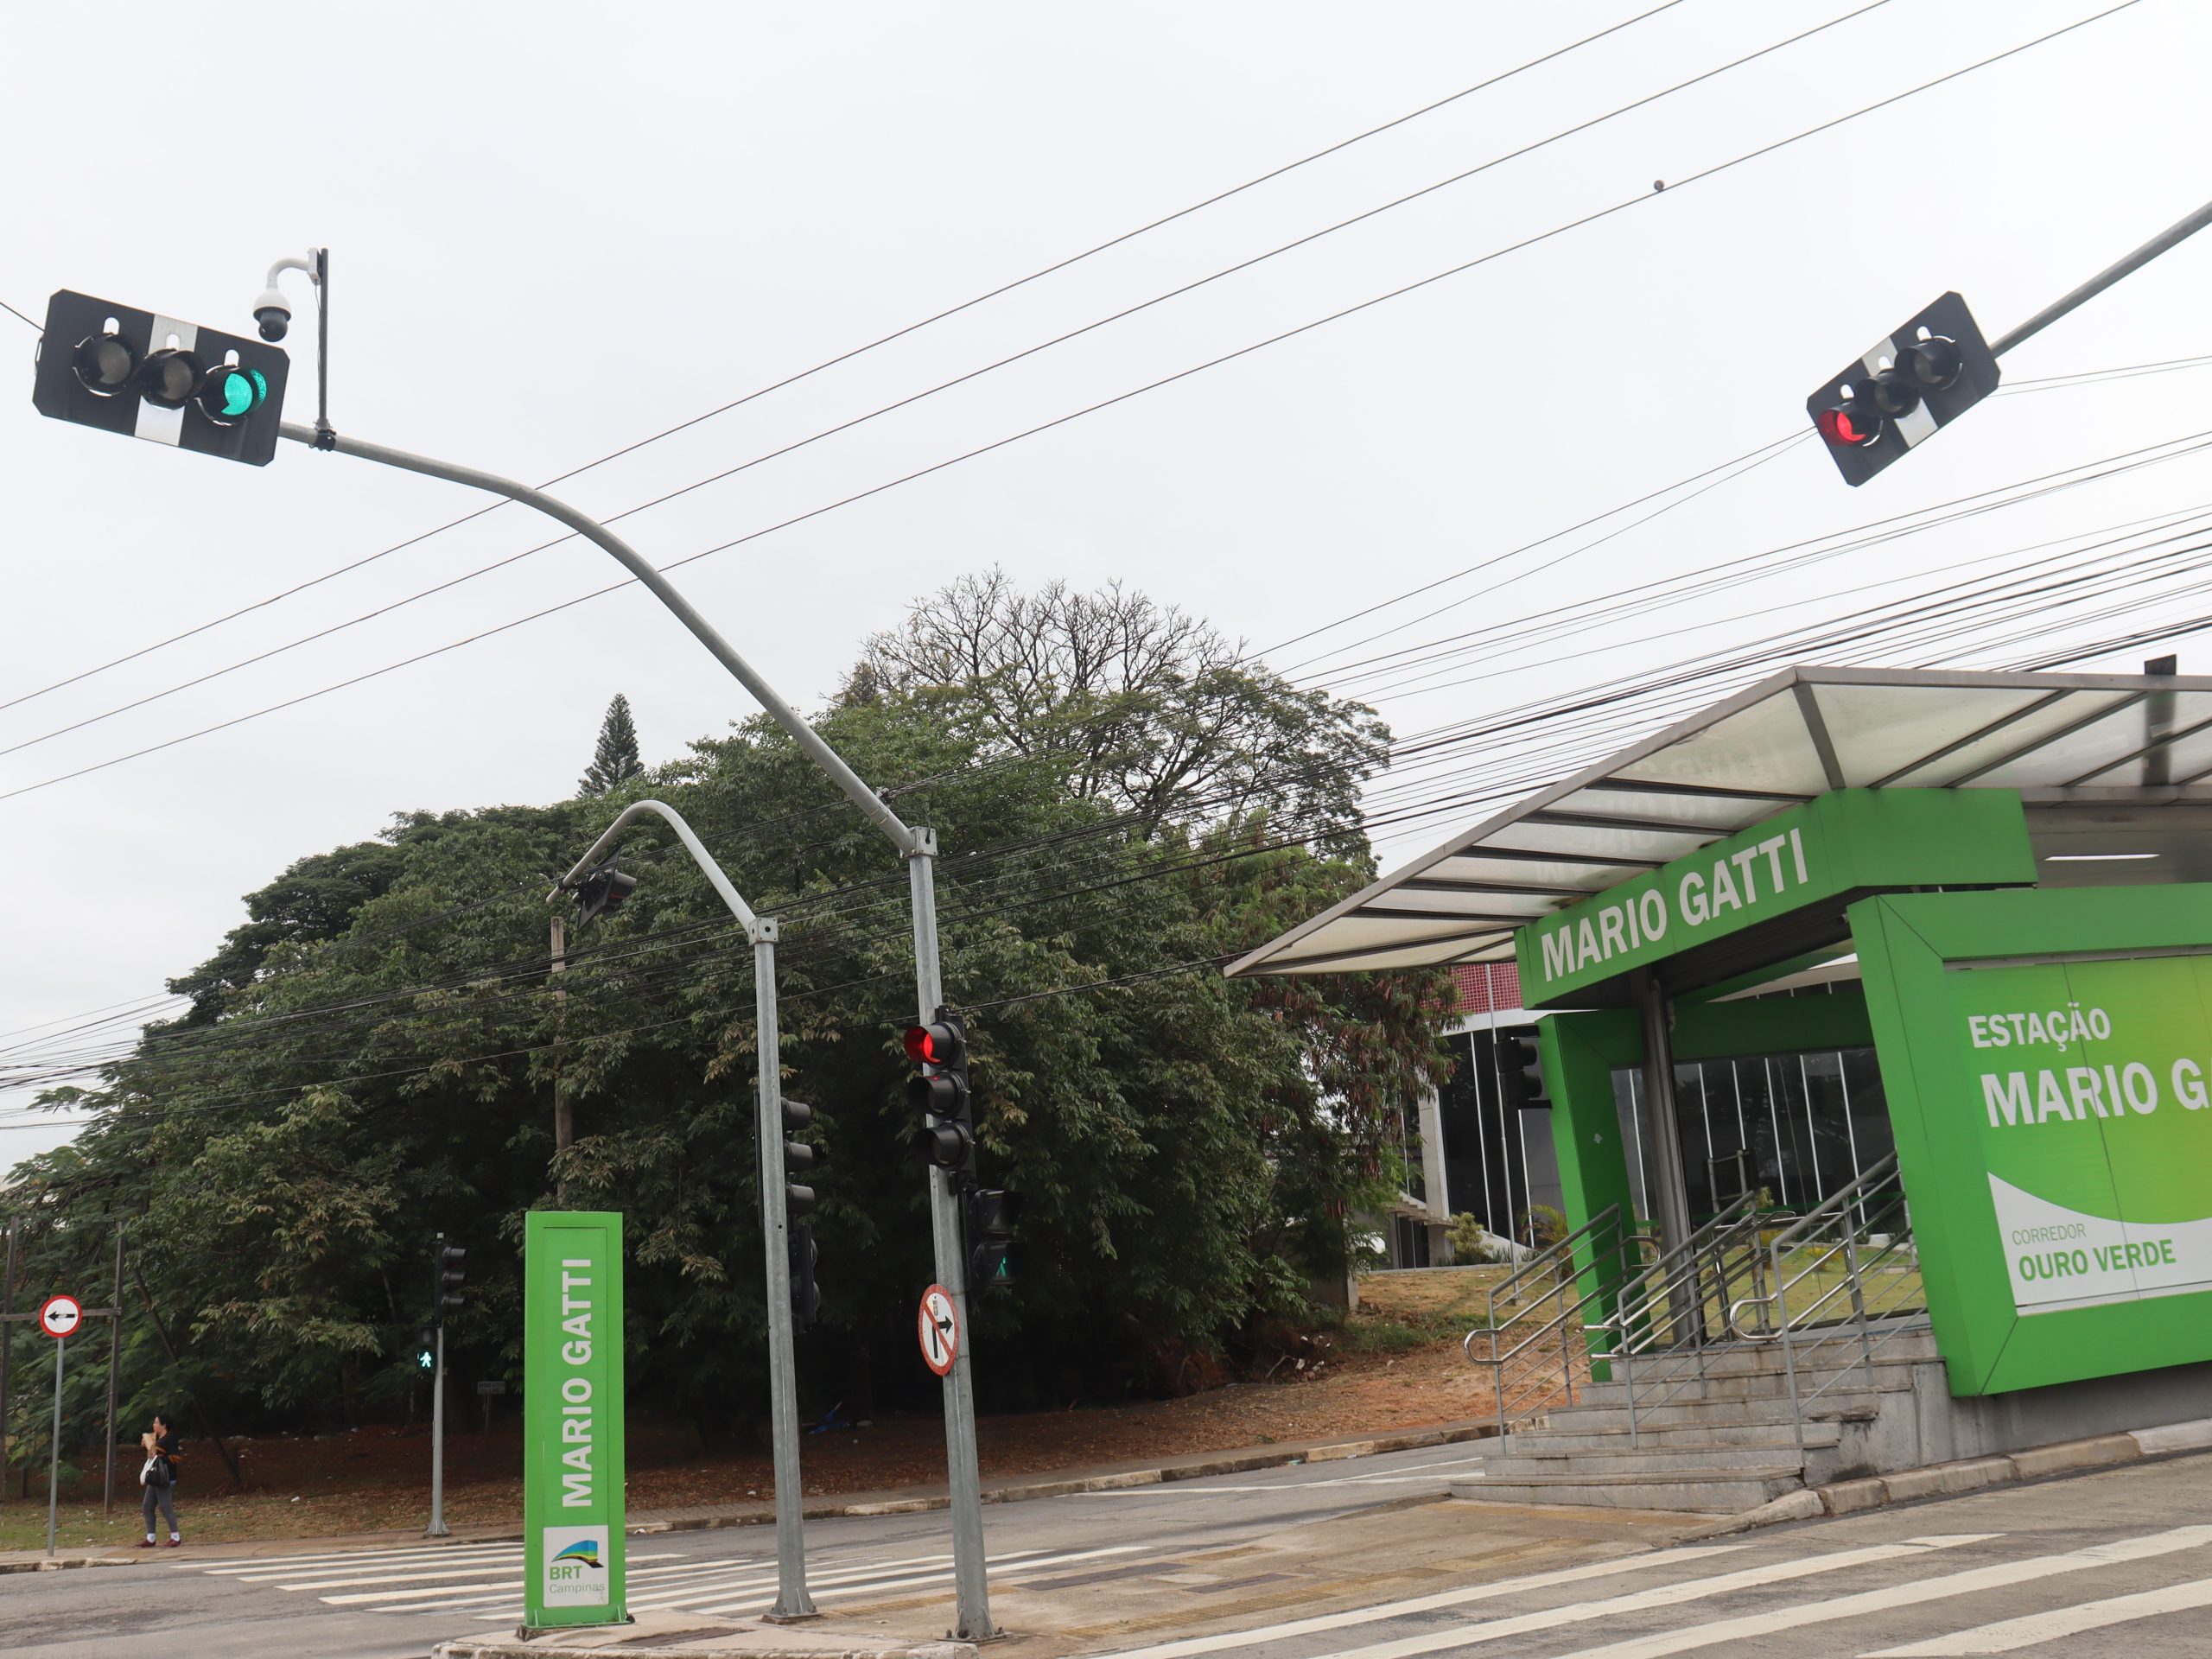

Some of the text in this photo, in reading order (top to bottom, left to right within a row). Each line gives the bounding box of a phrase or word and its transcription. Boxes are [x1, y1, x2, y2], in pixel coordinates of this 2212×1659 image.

[1541, 828, 1808, 982] MARIO GATTI
[1967, 1001, 2112, 1052] ESTAÇÃO
[1980, 1058, 2212, 1128] MARIO G
[2012, 1223, 2088, 1246] CORREDOR
[2018, 1238, 2177, 1281] OURO VERDE
[562, 1258, 593, 1508] MARIO GATTI
[549, 1565, 583, 1580] BRT
[549, 1582, 606, 1594] Campinas
